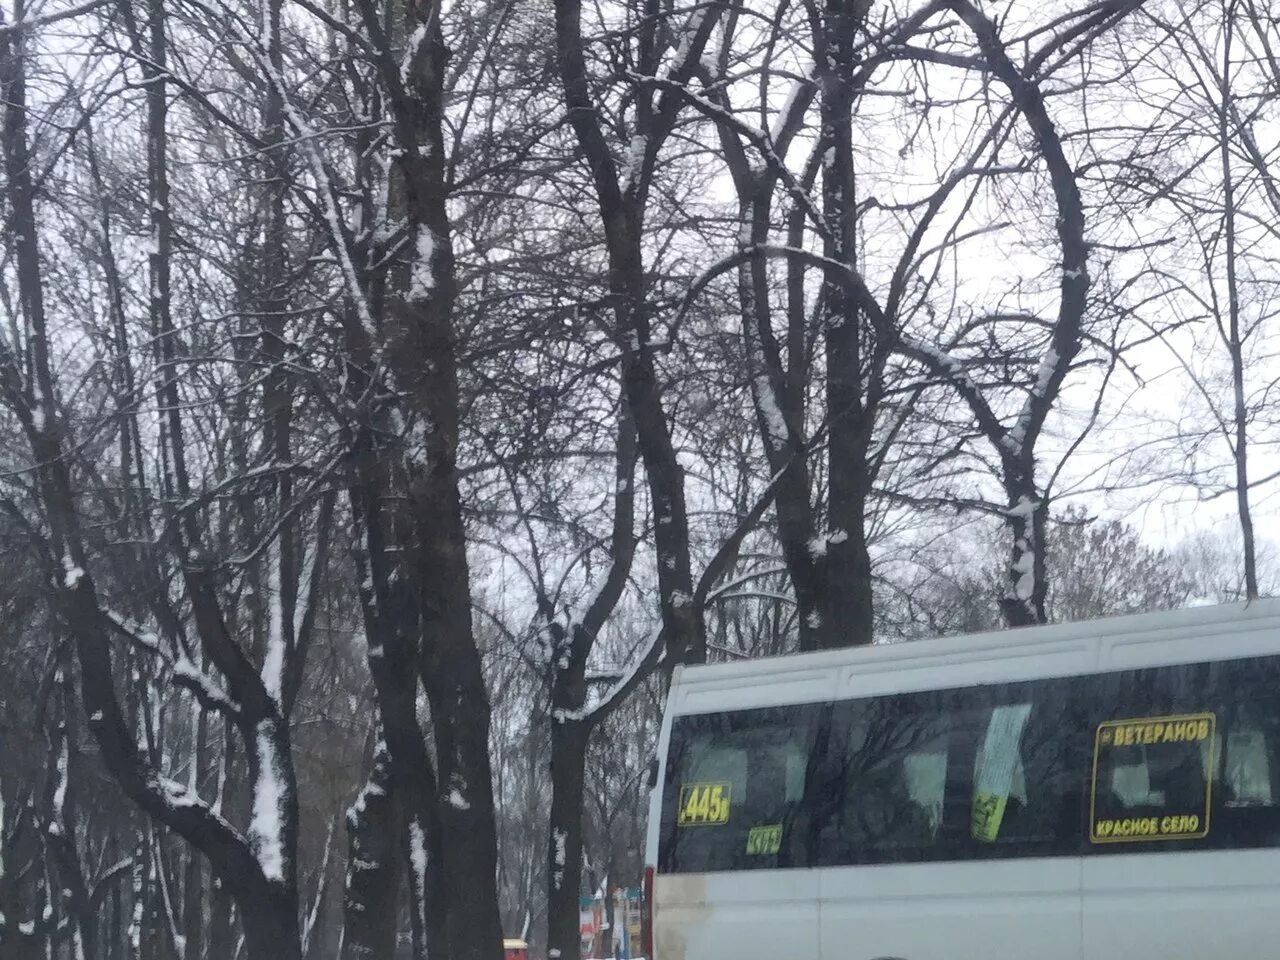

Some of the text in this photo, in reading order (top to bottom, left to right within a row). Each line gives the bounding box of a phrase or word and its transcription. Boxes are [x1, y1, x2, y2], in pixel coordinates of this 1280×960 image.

[1113, 720, 1209, 746] ВЕТЕРАНОВ
[1096, 814, 1199, 837] КРАСНОЕ СЕЛО
